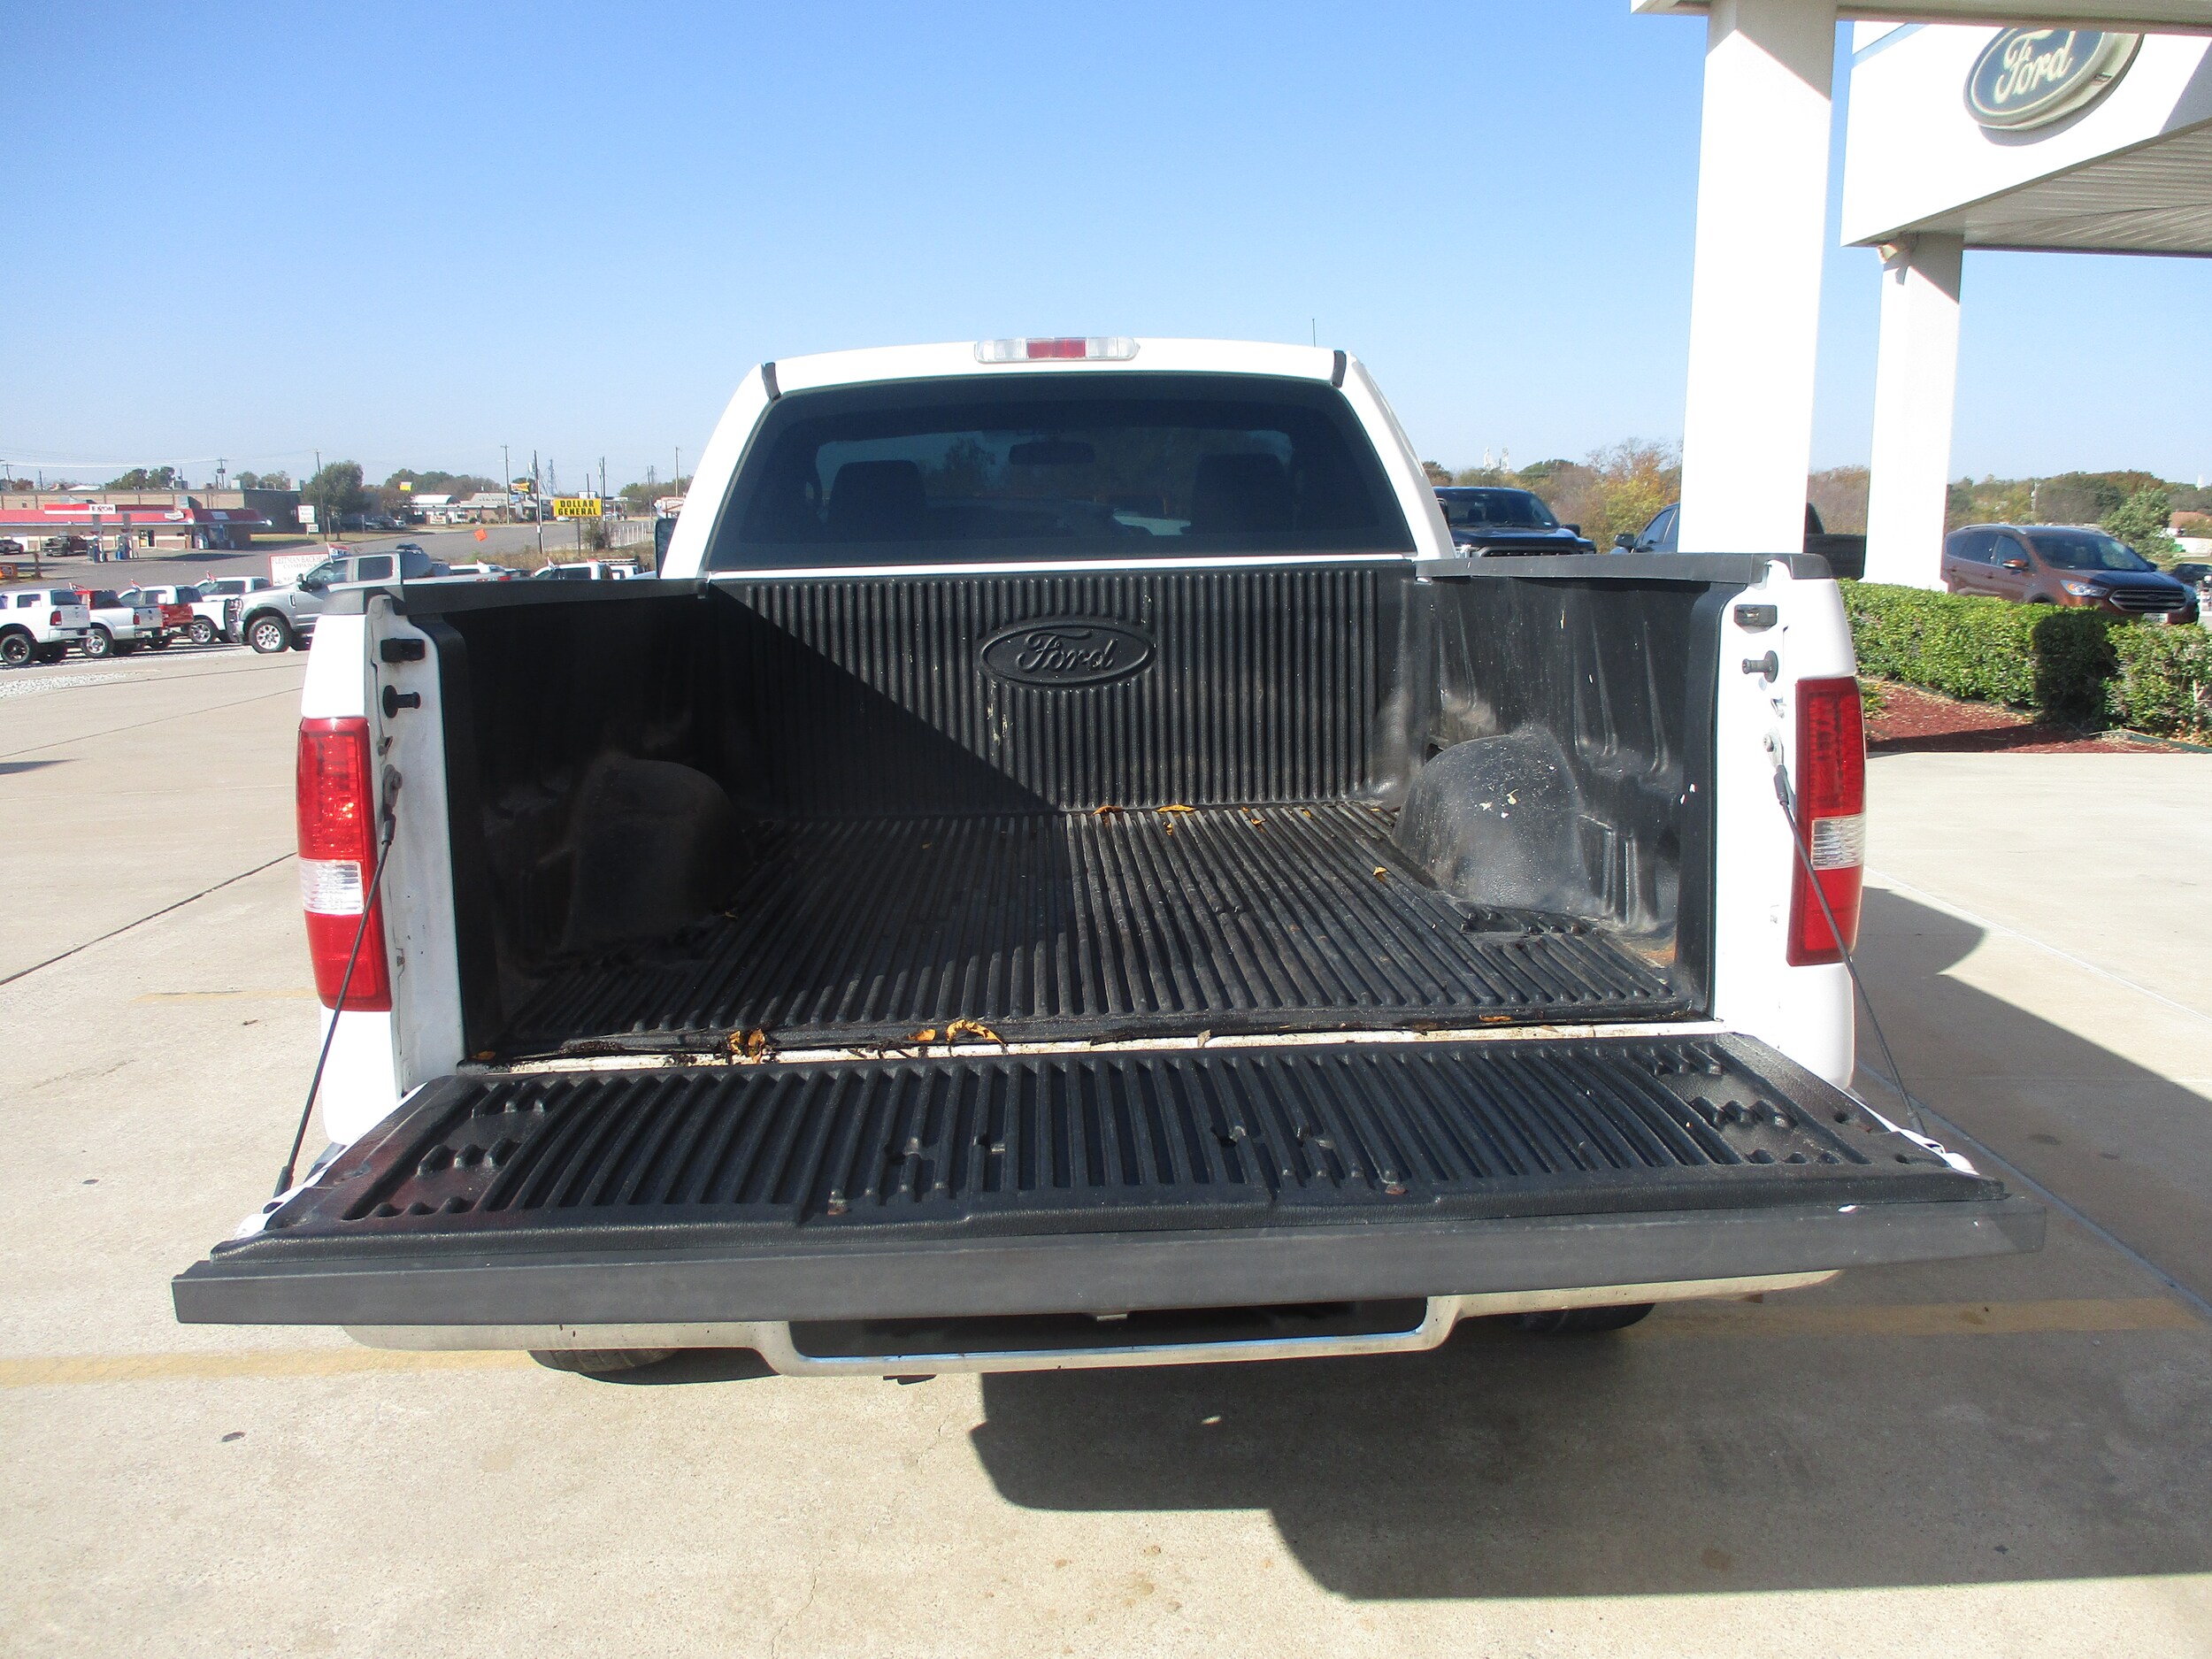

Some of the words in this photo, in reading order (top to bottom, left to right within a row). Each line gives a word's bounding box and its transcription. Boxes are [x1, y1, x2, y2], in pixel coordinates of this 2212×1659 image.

[1993, 29, 2074, 104] Ford
[558, 507, 598, 516] GENERAL
[1016, 631, 1118, 673] Ford
